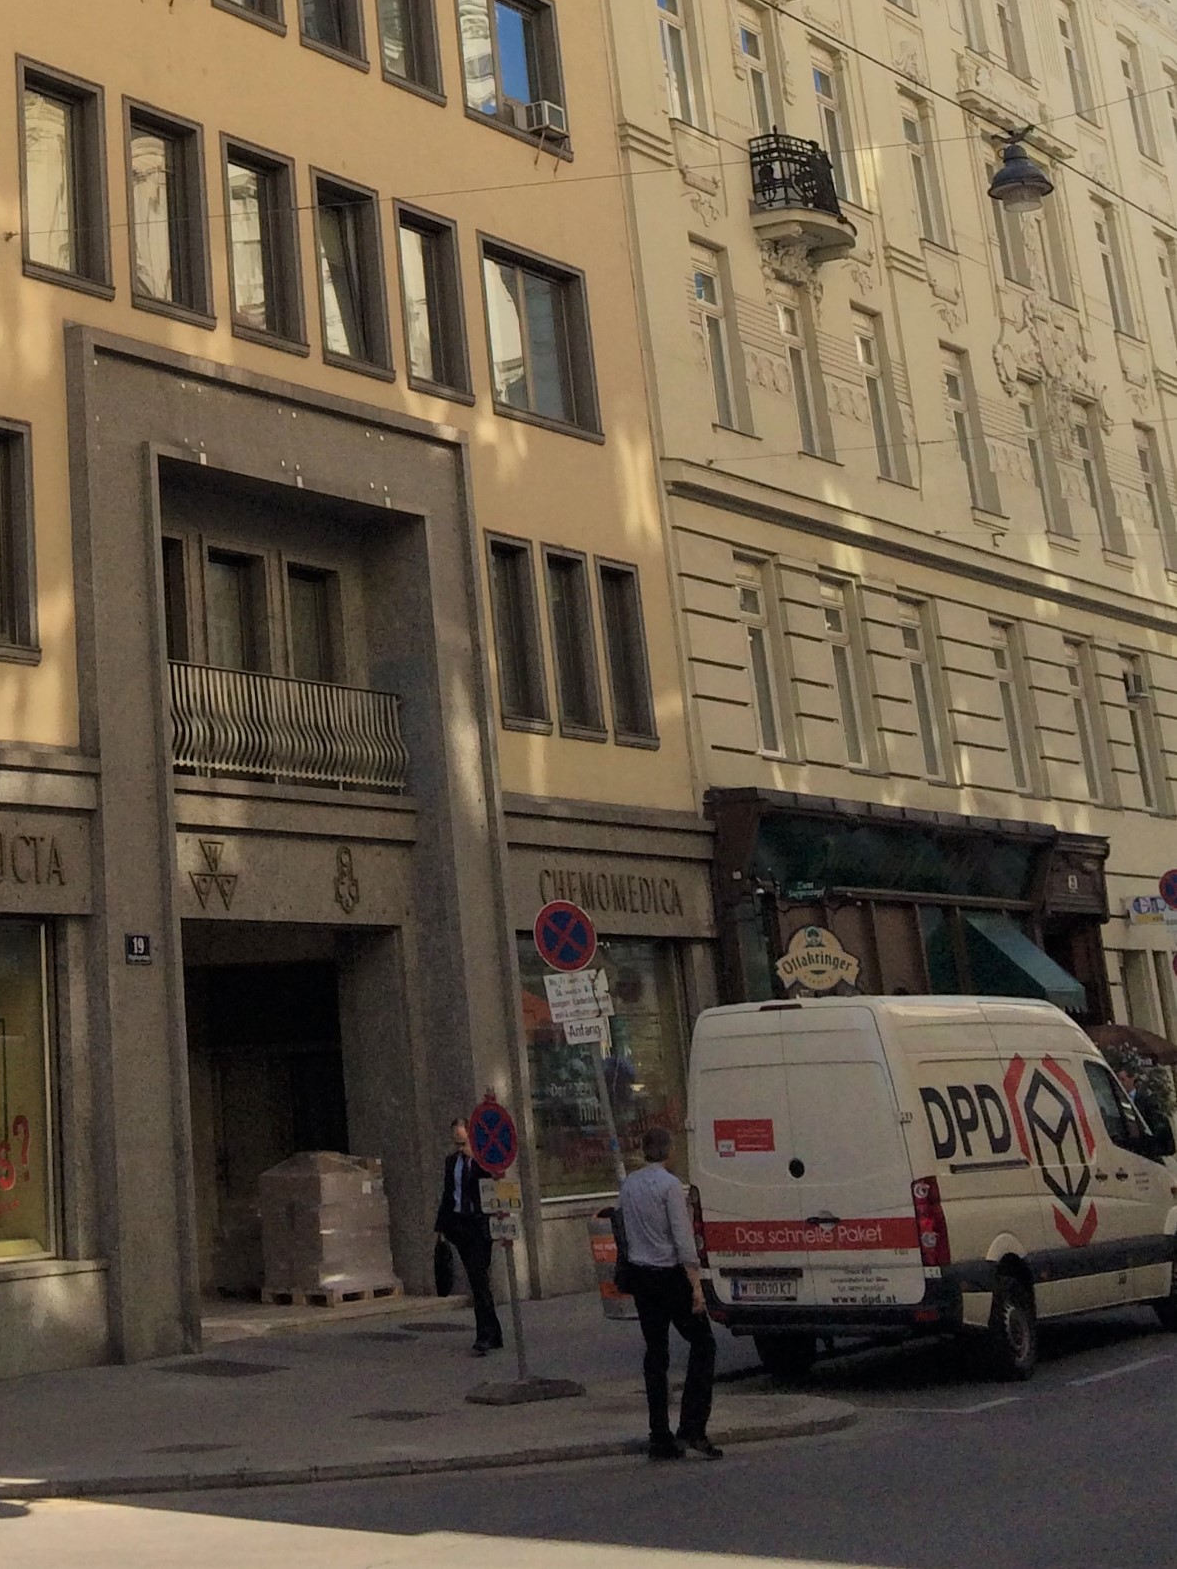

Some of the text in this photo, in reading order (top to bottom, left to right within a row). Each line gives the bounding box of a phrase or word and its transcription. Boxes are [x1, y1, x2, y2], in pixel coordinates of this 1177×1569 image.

[538, 868, 685, 918] CHEMOMEDICA
[132, 936, 145, 954] 19
[782, 951, 853, 975] Ottakringer
[569, 1023, 601, 1038] Anfang
[918, 1084, 1012, 1160] DPD
[735, 1225, 883, 1245] Das schnelle Paket
[831, 1293, 898, 1306] www.dpd.at
